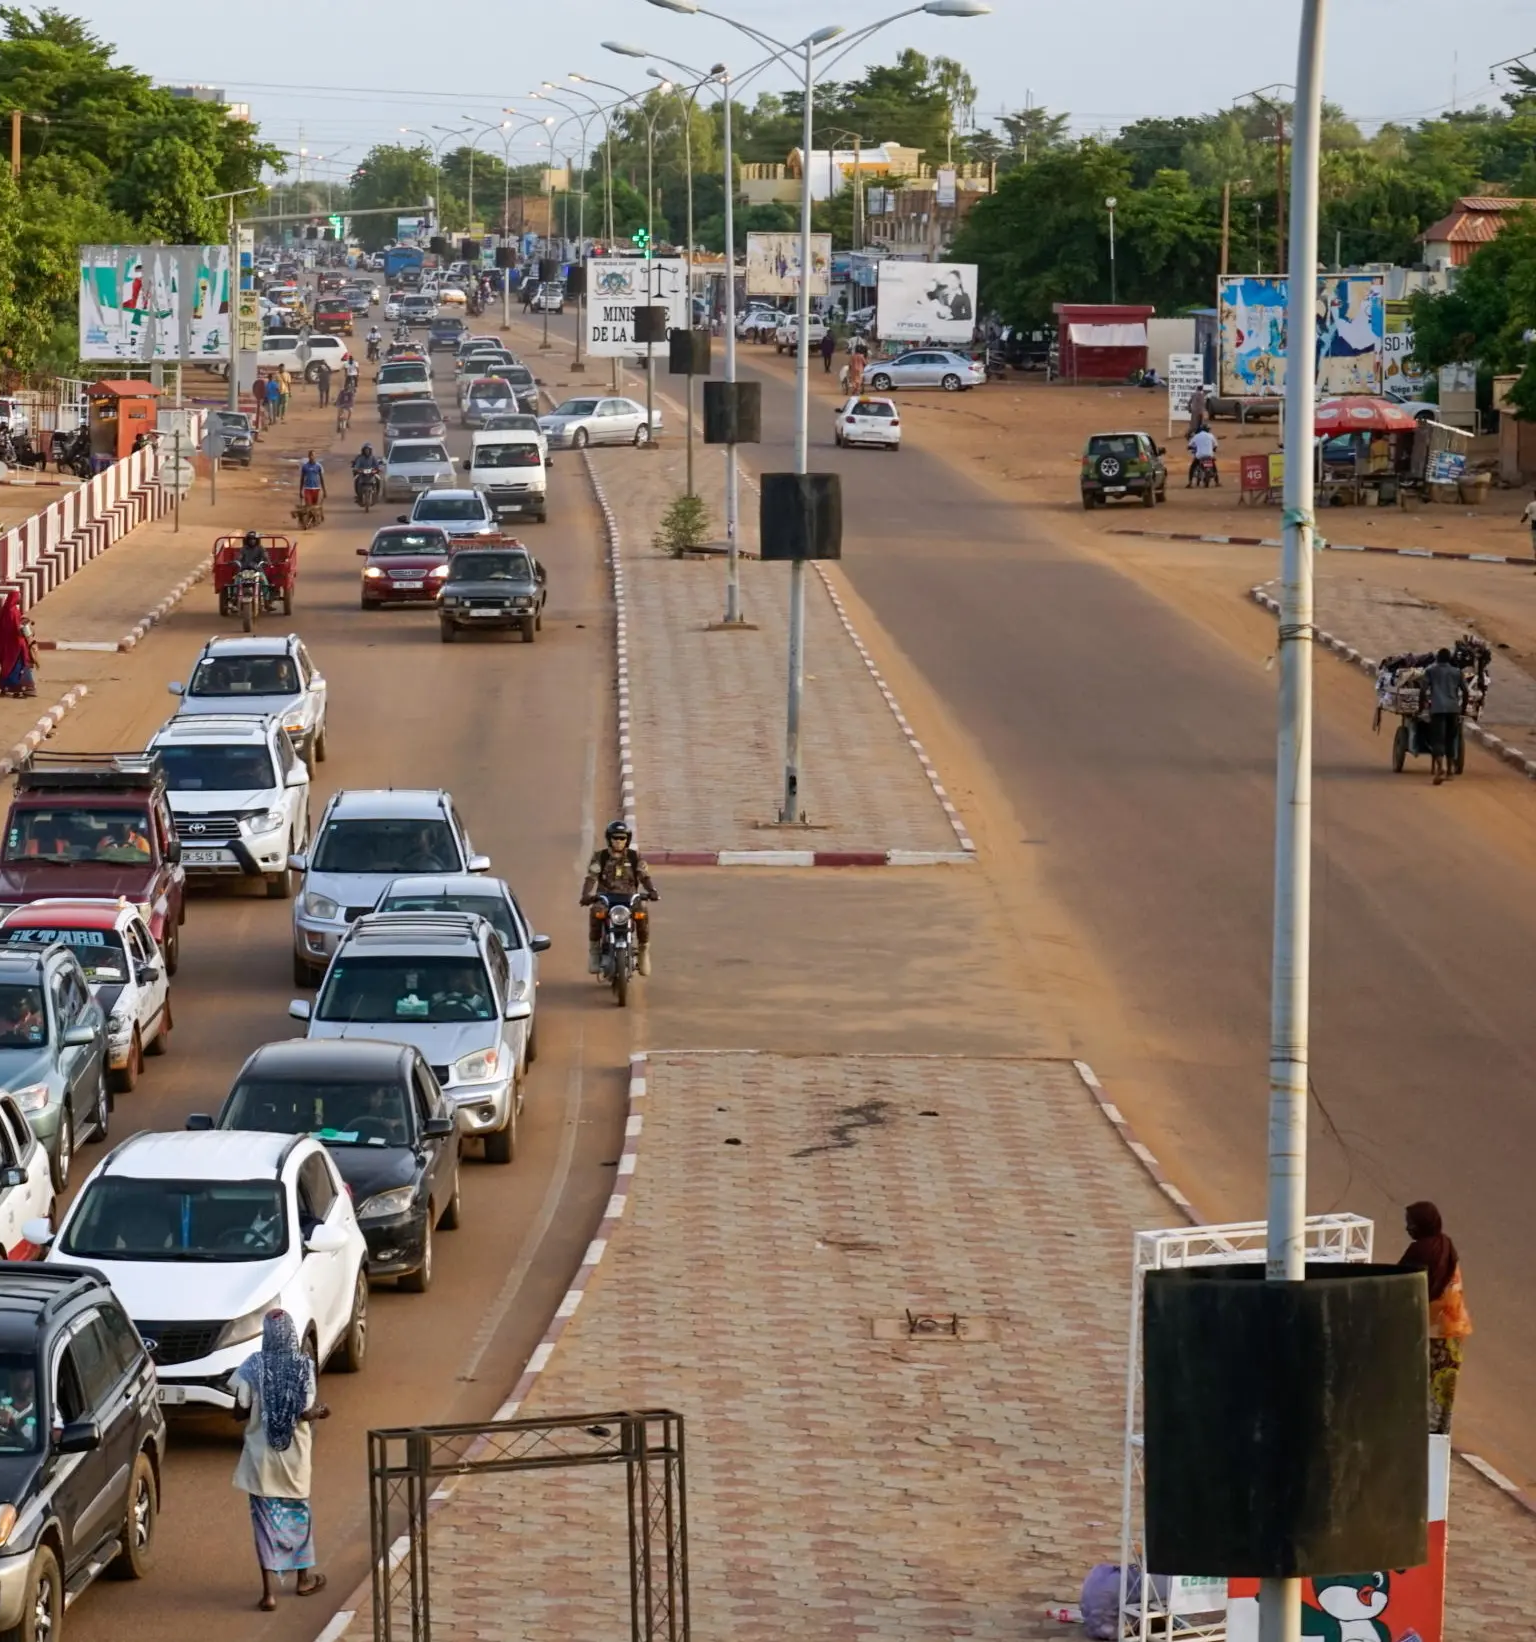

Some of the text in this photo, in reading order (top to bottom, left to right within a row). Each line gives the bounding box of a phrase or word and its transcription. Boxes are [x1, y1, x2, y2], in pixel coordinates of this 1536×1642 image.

[603, 306, 671, 321] MINISE
[592, 327, 609, 342] DE
[612, 327, 628, 342] LA
